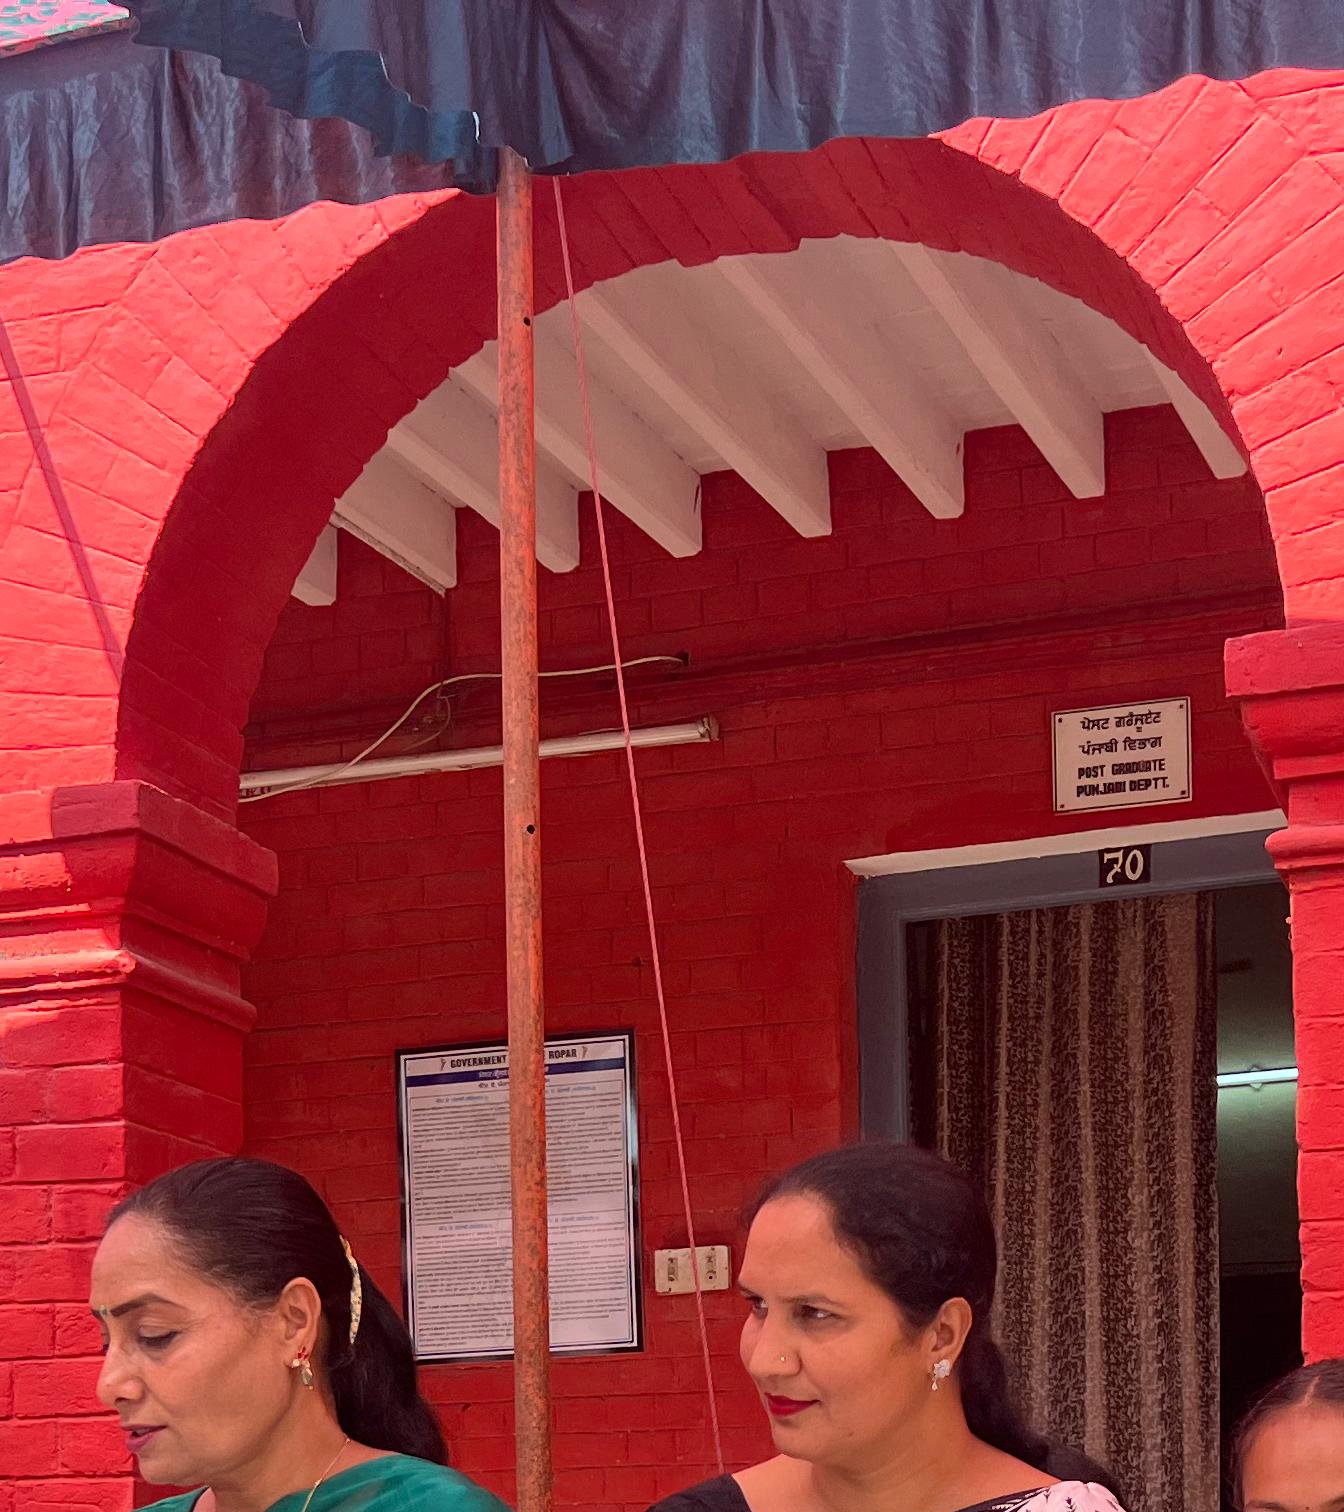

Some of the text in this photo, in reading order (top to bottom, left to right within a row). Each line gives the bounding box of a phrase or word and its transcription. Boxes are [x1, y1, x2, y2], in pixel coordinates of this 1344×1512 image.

[1077, 758, 1166, 780] POST GRADUATE
[1076, 780, 1126, 798] PUNJABI
[1103, 848, 1144, 884] 70
[450, 1055, 507, 1069] GOVERNMENT
[548, 1048, 578, 1060] ROPAR
